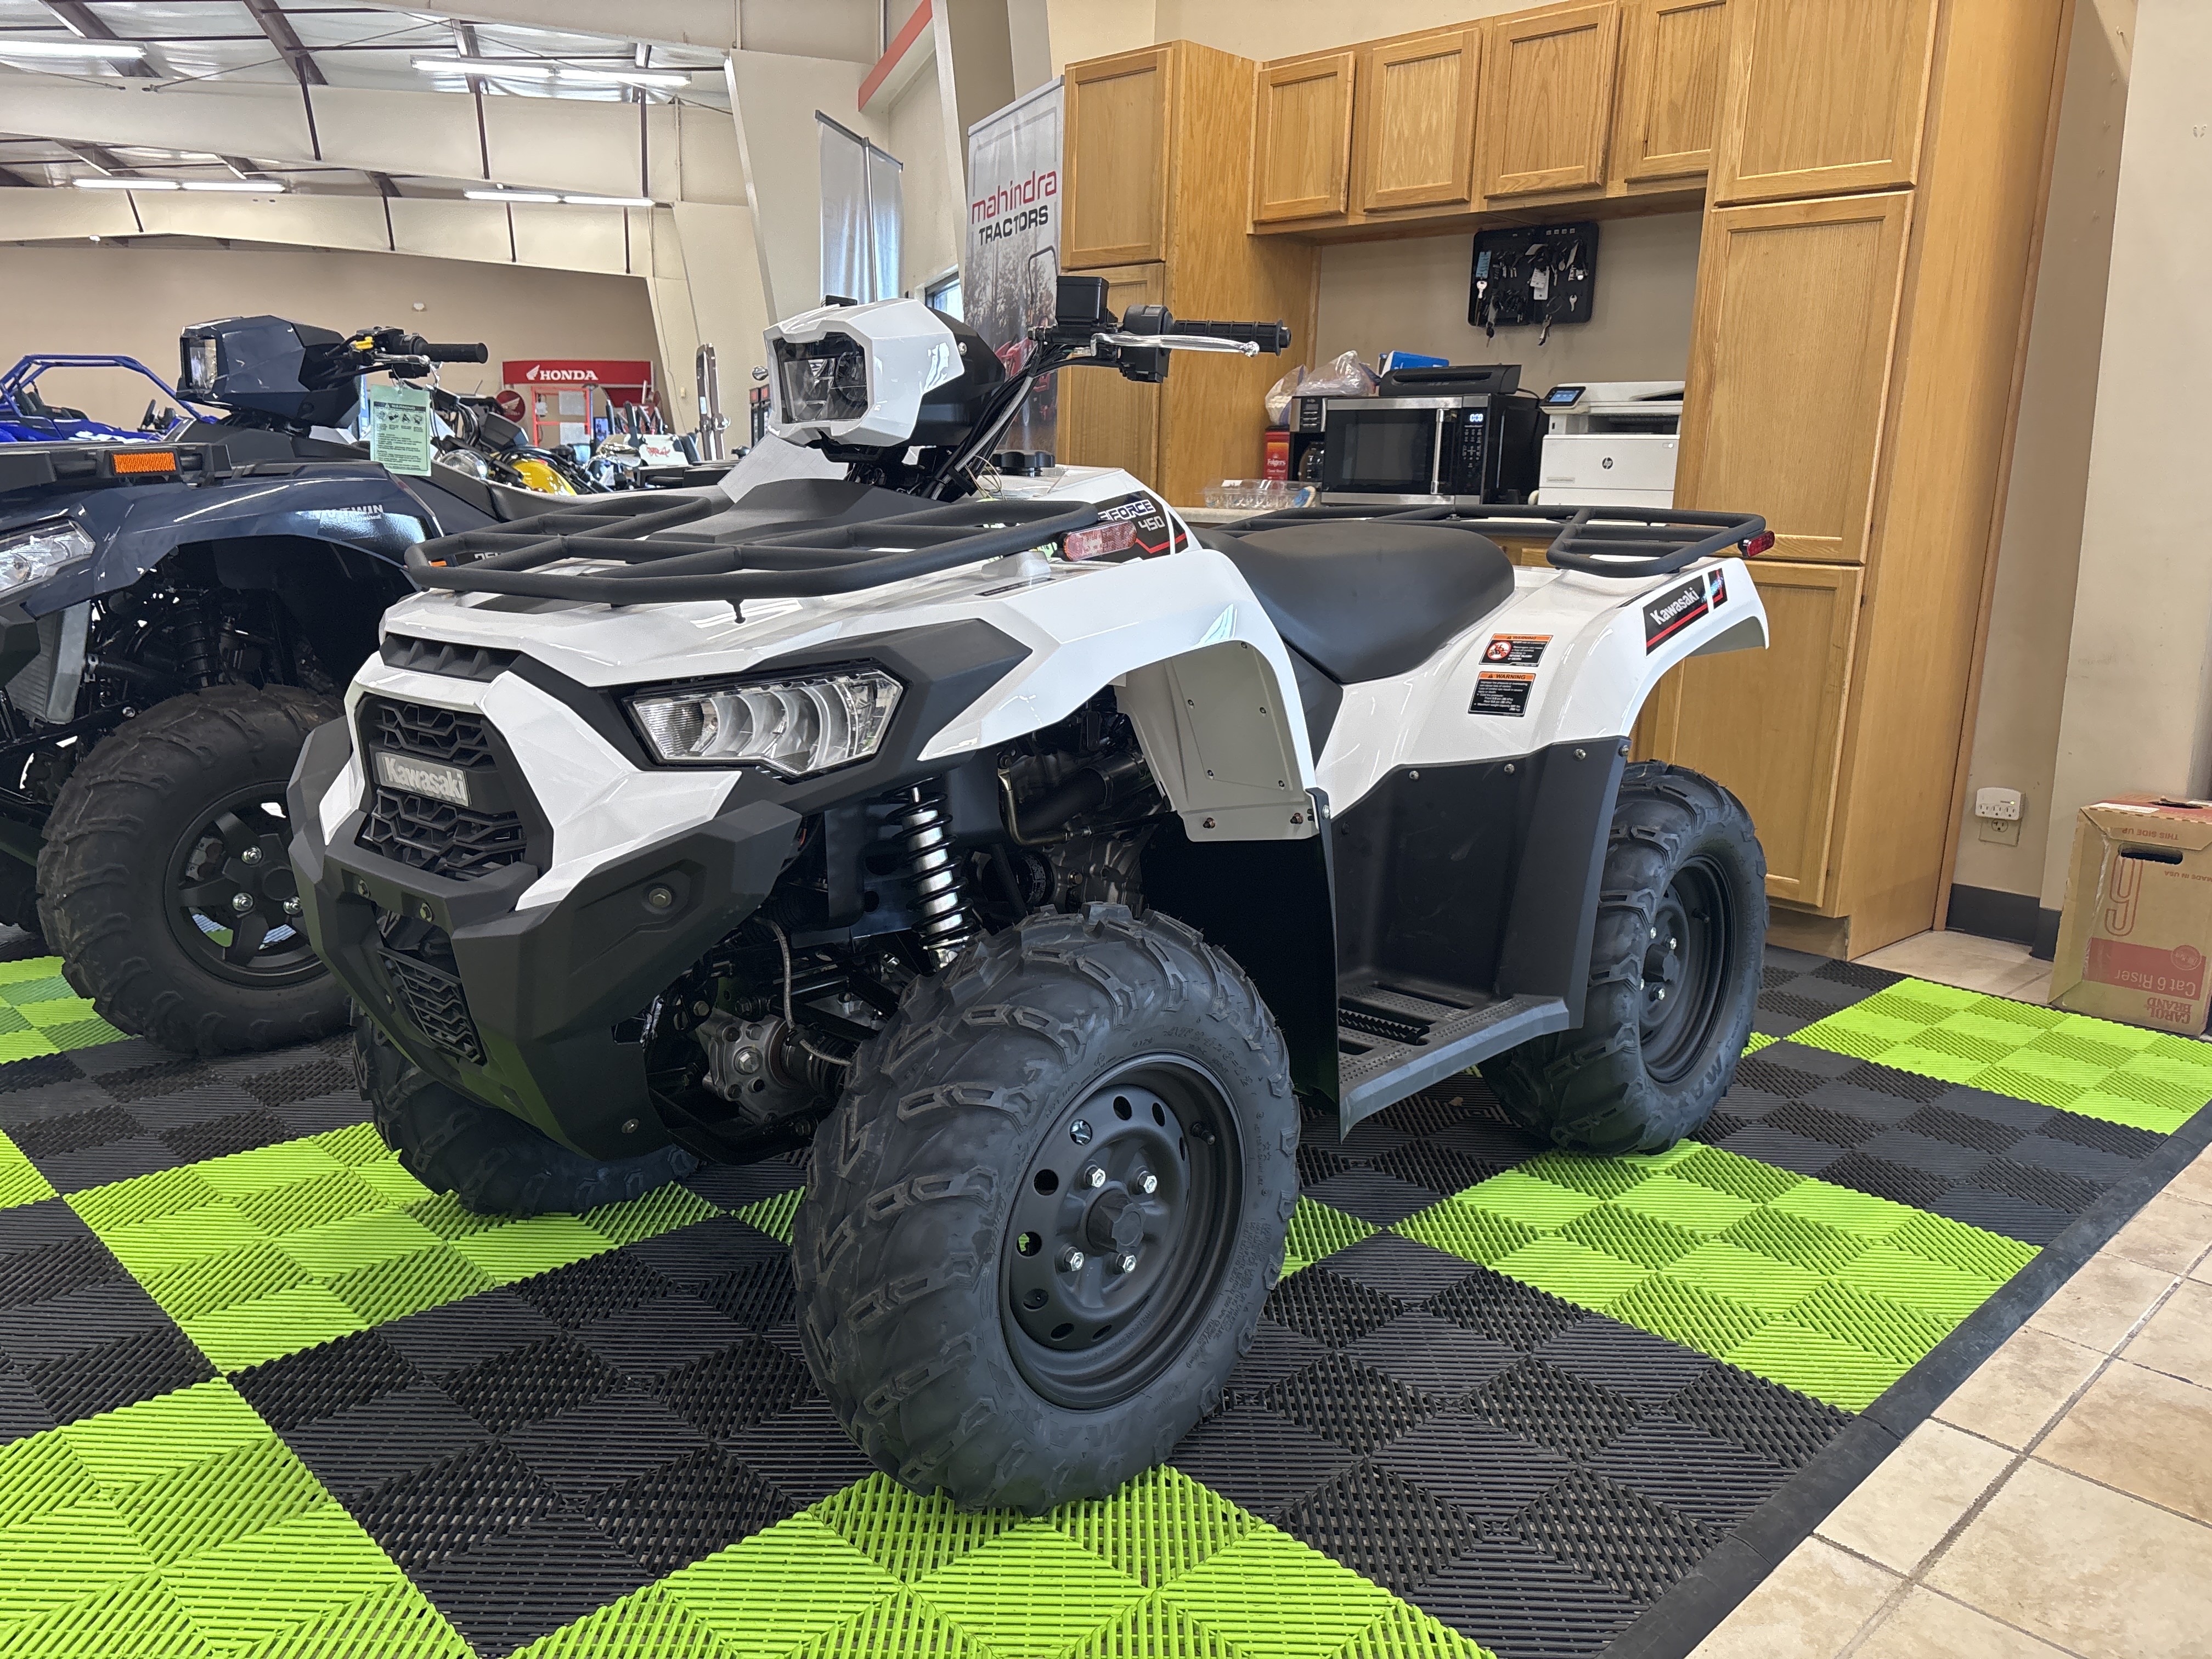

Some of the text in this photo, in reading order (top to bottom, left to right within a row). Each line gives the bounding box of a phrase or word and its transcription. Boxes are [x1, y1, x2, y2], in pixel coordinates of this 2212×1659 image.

[972, 170, 1057, 224] mahindra
[979, 205, 1048, 246] TRACTORS
[540, 370, 599, 381] HONDA
[1267, 459, 1286, 467] Folgers
[1602, 458, 1613, 469] hp
[1108, 500, 1156, 521] FORCE
[1138, 516, 1165, 531] 450
[1650, 586, 1699, 625] Kawasaki
[382, 757, 466, 800] Kawasaki
[2136, 829, 2157, 838] SIDE
[2159, 832, 2179, 840] THIS
[2114, 969, 2196, 997] Cat 6 Riser
[2147, 997, 2193, 1013] BRAND
[2148, 1007, 2191, 1024] CAROL
